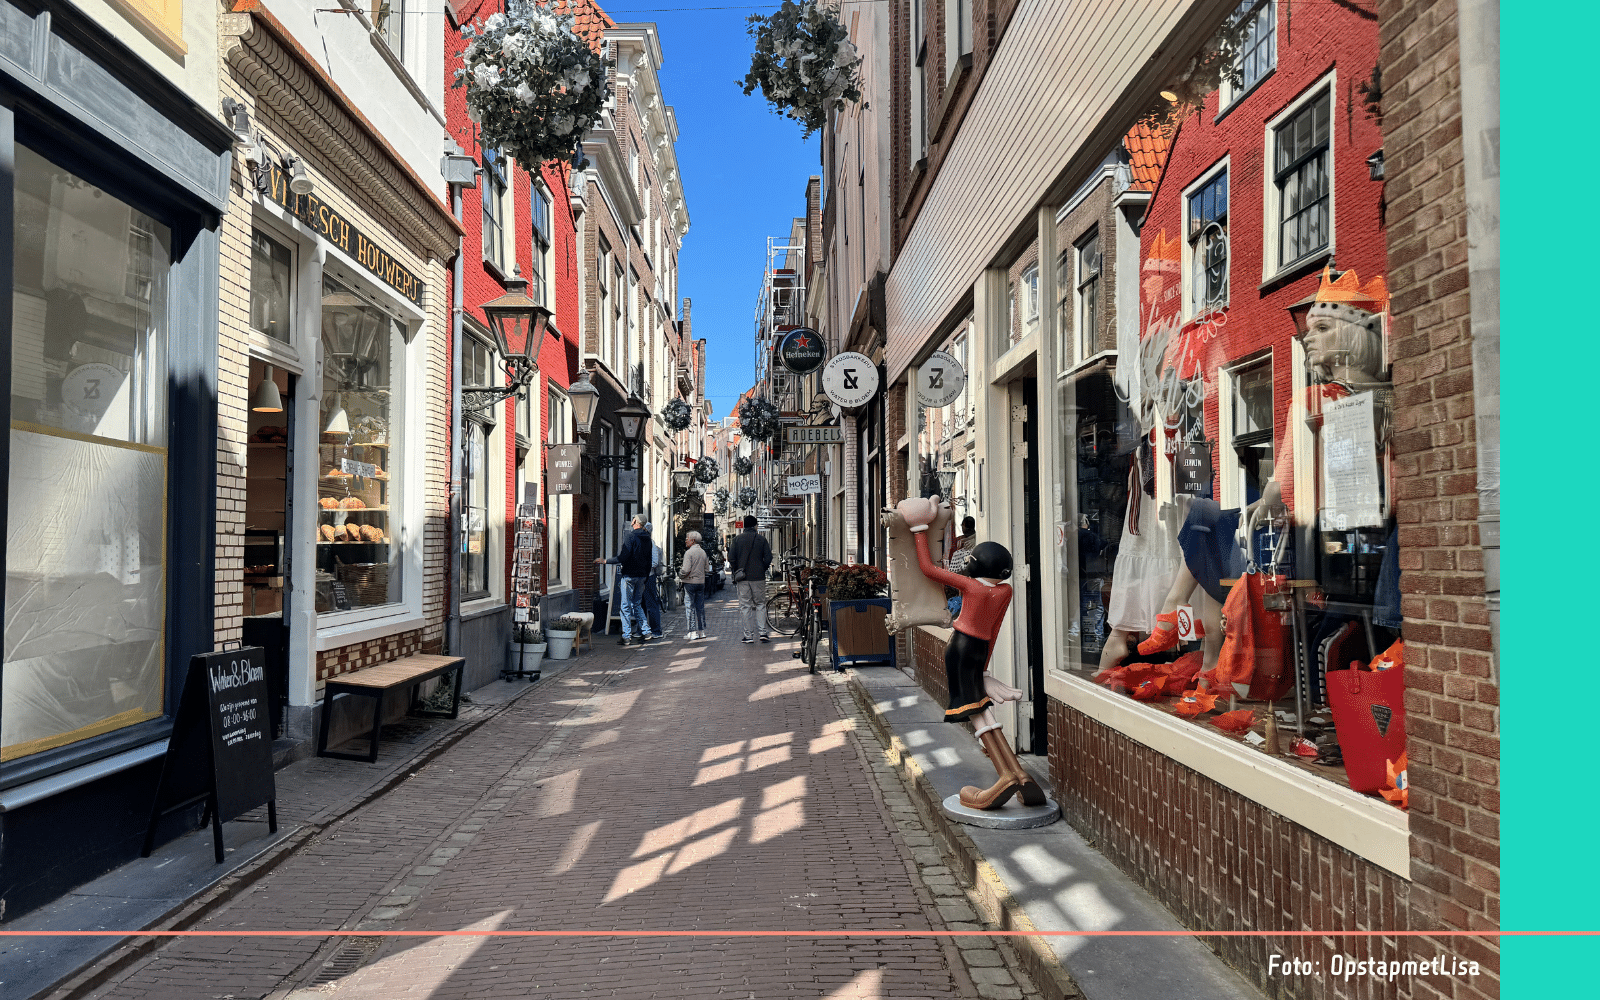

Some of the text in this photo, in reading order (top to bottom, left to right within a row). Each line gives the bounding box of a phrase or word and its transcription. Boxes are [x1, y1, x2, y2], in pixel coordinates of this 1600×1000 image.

[357, 233, 418, 301] HOUWERIJ
[785, 350, 820, 359] Heineken
[830, 389, 848, 403] WATER
[854, 389, 873, 403] BLOEM
